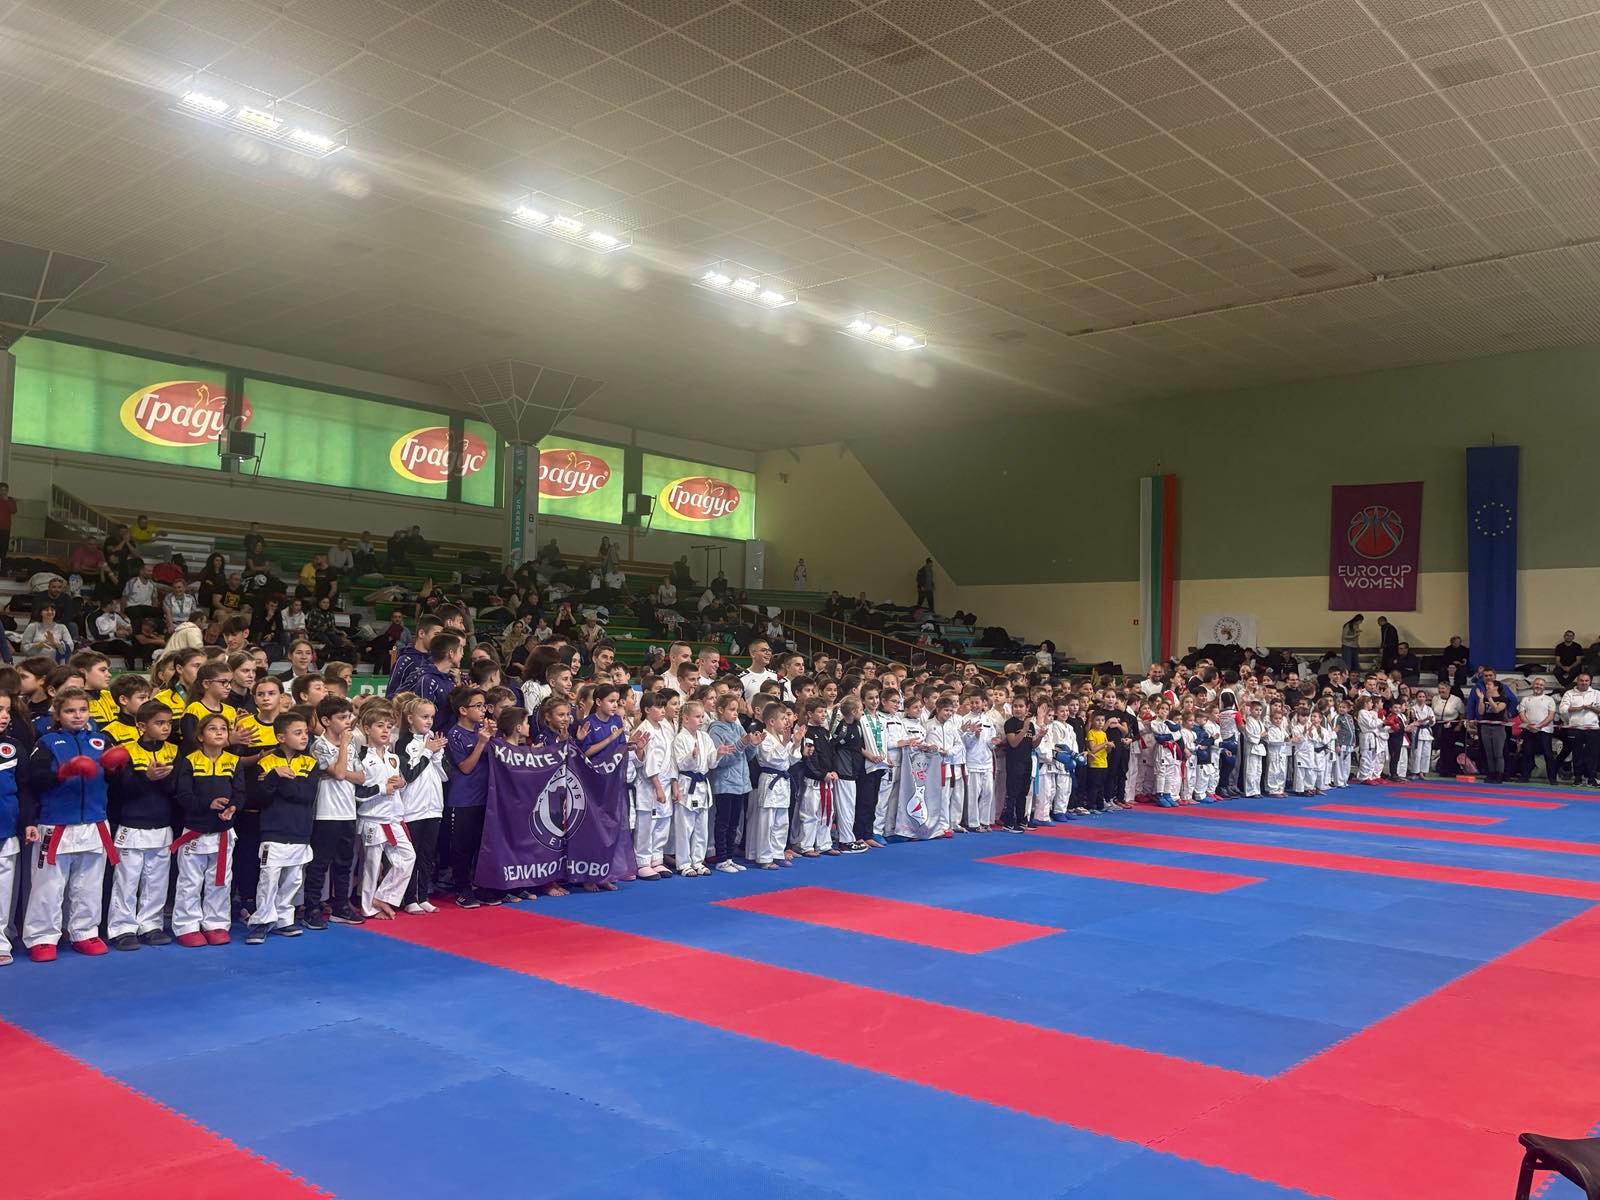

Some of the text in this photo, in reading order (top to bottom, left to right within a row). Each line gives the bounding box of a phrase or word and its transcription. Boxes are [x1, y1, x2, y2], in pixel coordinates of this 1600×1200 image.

[669, 484, 737, 517] Градус
[1338, 565, 1412, 577] EUROCUP
[1343, 577, 1404, 589] WOMEN
[494, 744, 558, 768] КАРАТЕ
